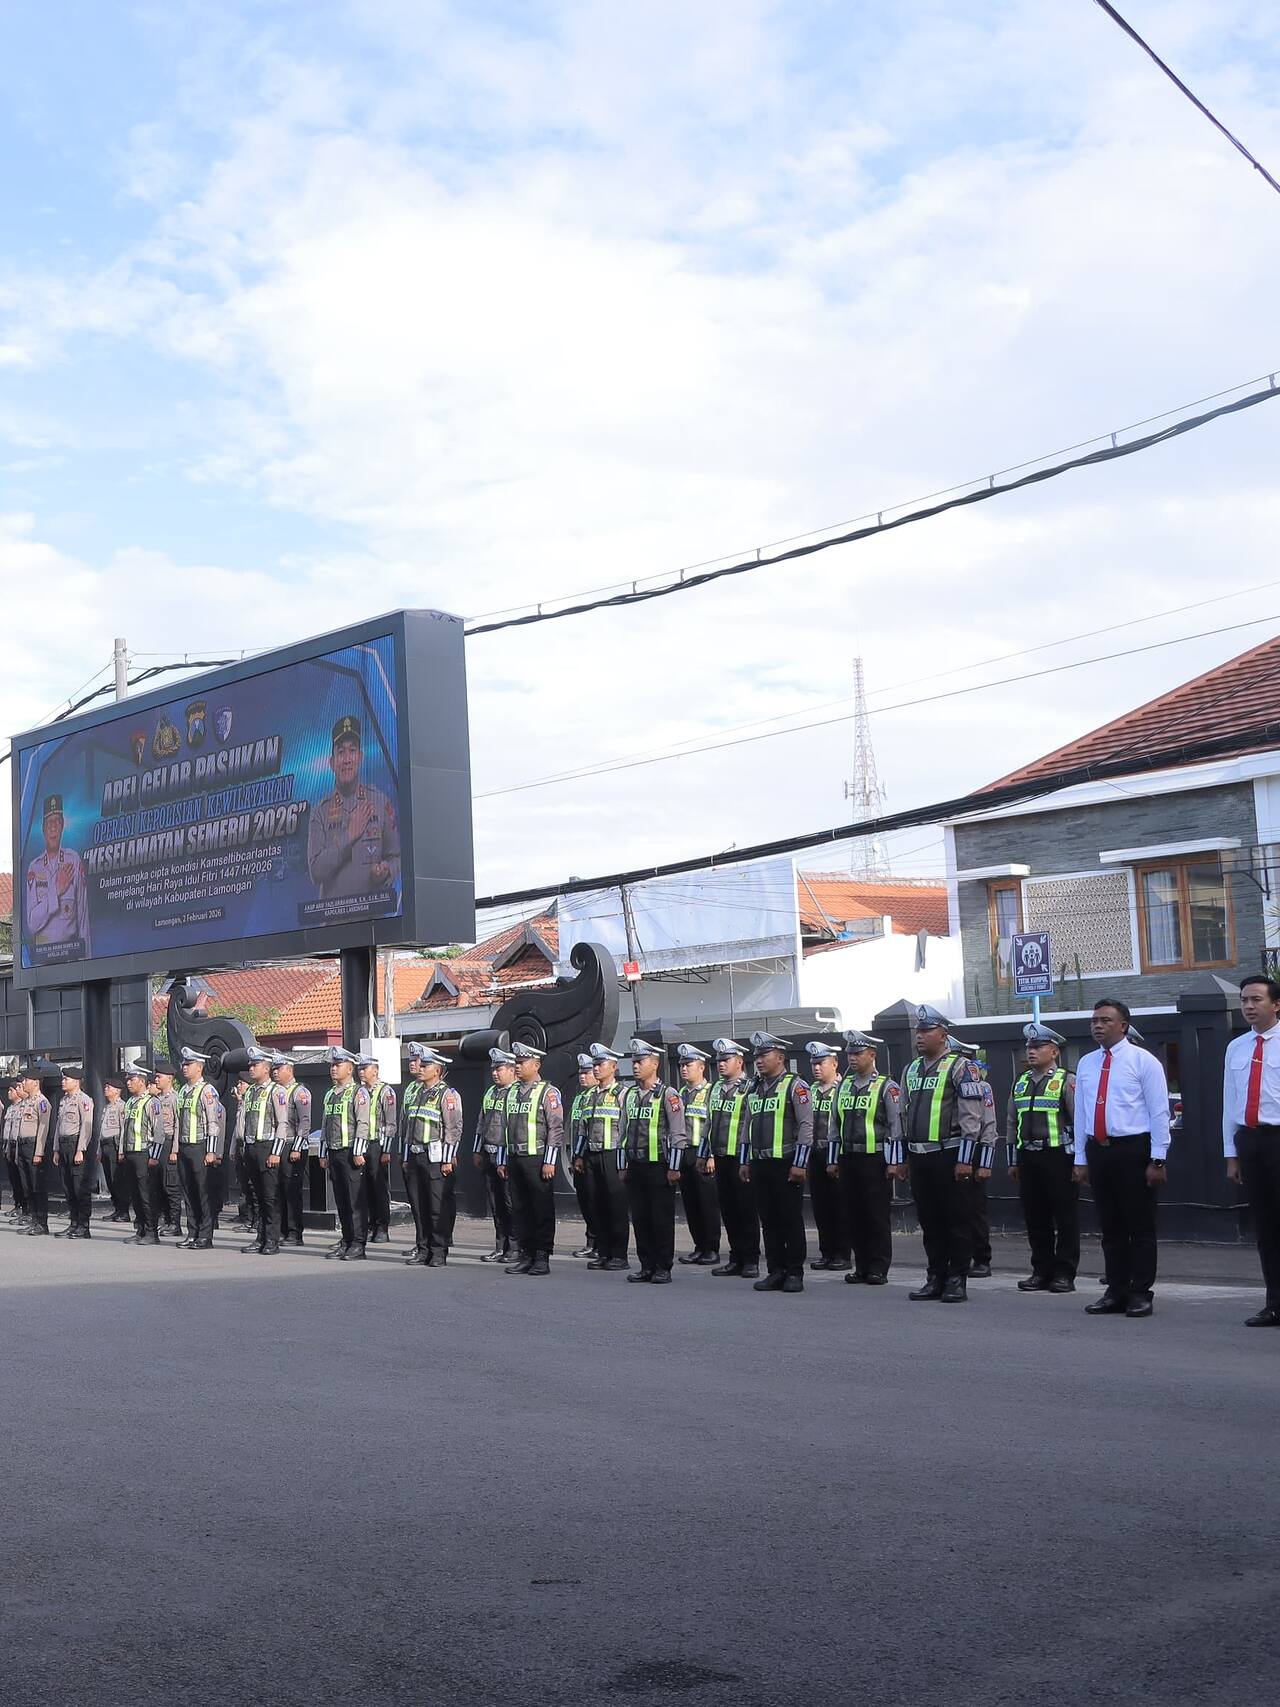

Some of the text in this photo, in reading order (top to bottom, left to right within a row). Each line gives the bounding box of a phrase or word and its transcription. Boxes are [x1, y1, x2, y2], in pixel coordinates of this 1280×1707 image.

[103, 735, 281, 806] APEL GELAR PASUKAN
[93, 775, 295, 844] OPERASI KEPOLISIAN KEWILAYAHAN
[187, 814, 250, 854] SEMERU
[99, 844, 282, 889] Dalam rangka cipta kondisi Kamseltibcarlantas
[107, 859, 273, 900] menjelang Hari Raya Idul Fitri 1447 H/2026
[126, 879, 253, 910] di wilayah Kabupaten Lamongan
[186, 910, 208, 923] Februari
[208, 908, 222, 919] 2026
[909, 1077, 939, 1091] POLISI
[711, 1100, 736, 1112] POLISI
[840, 1097, 872, 1110] POLISI
